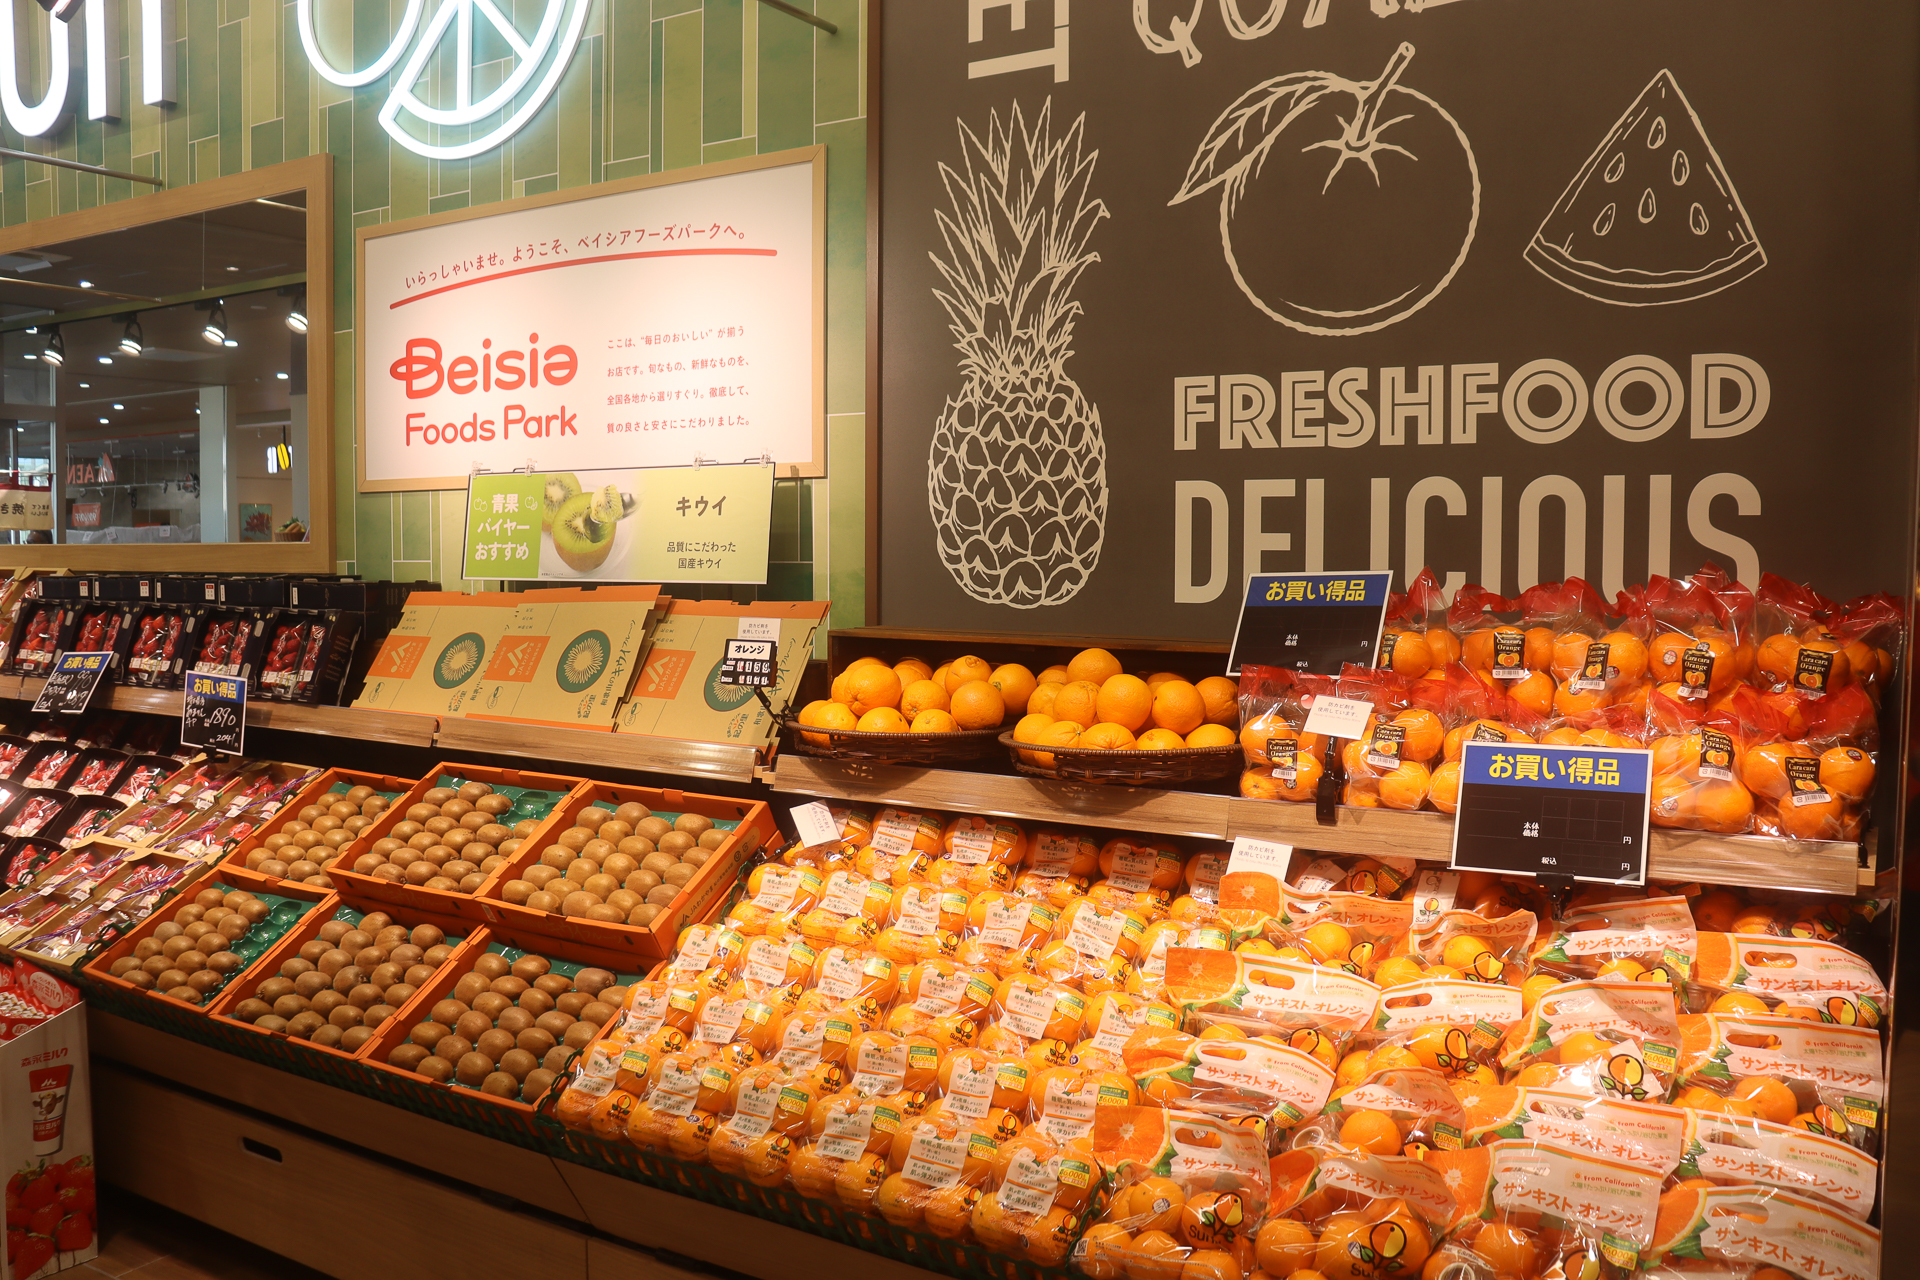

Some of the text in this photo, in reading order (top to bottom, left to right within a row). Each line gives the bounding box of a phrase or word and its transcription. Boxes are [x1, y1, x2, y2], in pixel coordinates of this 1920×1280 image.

[405, 404, 578, 447] Foods Park
[607, 415, 750, 434] 質の良さと安さにこだわりました。
[491, 493, 519, 514] 青果
[676, 495, 727, 517] キウイ
[477, 517, 531, 536] バイヤー
[666, 541, 736, 553] 品質にこだわった
[1174, 472, 1762, 605] DELICIOUS
[475, 541, 529, 561] おすすめ
[678, 558, 722, 569] 国産キウイ
[1265, 580, 1366, 602] お買い得品
[734, 644, 765, 655] オレンジ
[63, 656, 103, 669] お買い得品
[1800, 662, 1826, 672] Orange
[193, 677, 237, 699] お買い得品
[1317, 707, 1358, 718] 使用しています。
[1489, 753, 1620, 786] お買い得品
[1523, 822, 1540, 830] 本体
[1522, 830, 1632, 844] 価格 円
[1541, 857, 1630, 871] 税込 円
[1483, 920, 1529, 935] オレンジ
[1758, 977, 1826, 991] サンキスト
[1253, 994, 1364, 1015] サンキスト オレンジ
[21, 1047, 68, 1068] 森永ミルク
[1740, 1056, 1872, 1086] サンキスト オレンジ
[1207, 1066, 1316, 1103] サンキスト オレンジ
[1537, 1124, 1606, 1151] サンキスト
[1713, 1156, 1861, 1201] サンキスト オレンジ
[1394, 1185, 1448, 1205] オレンジ
[1503, 1183, 1643, 1228] サンキスト オレンジ
[1716, 1228, 1794, 1262] サンキスト
